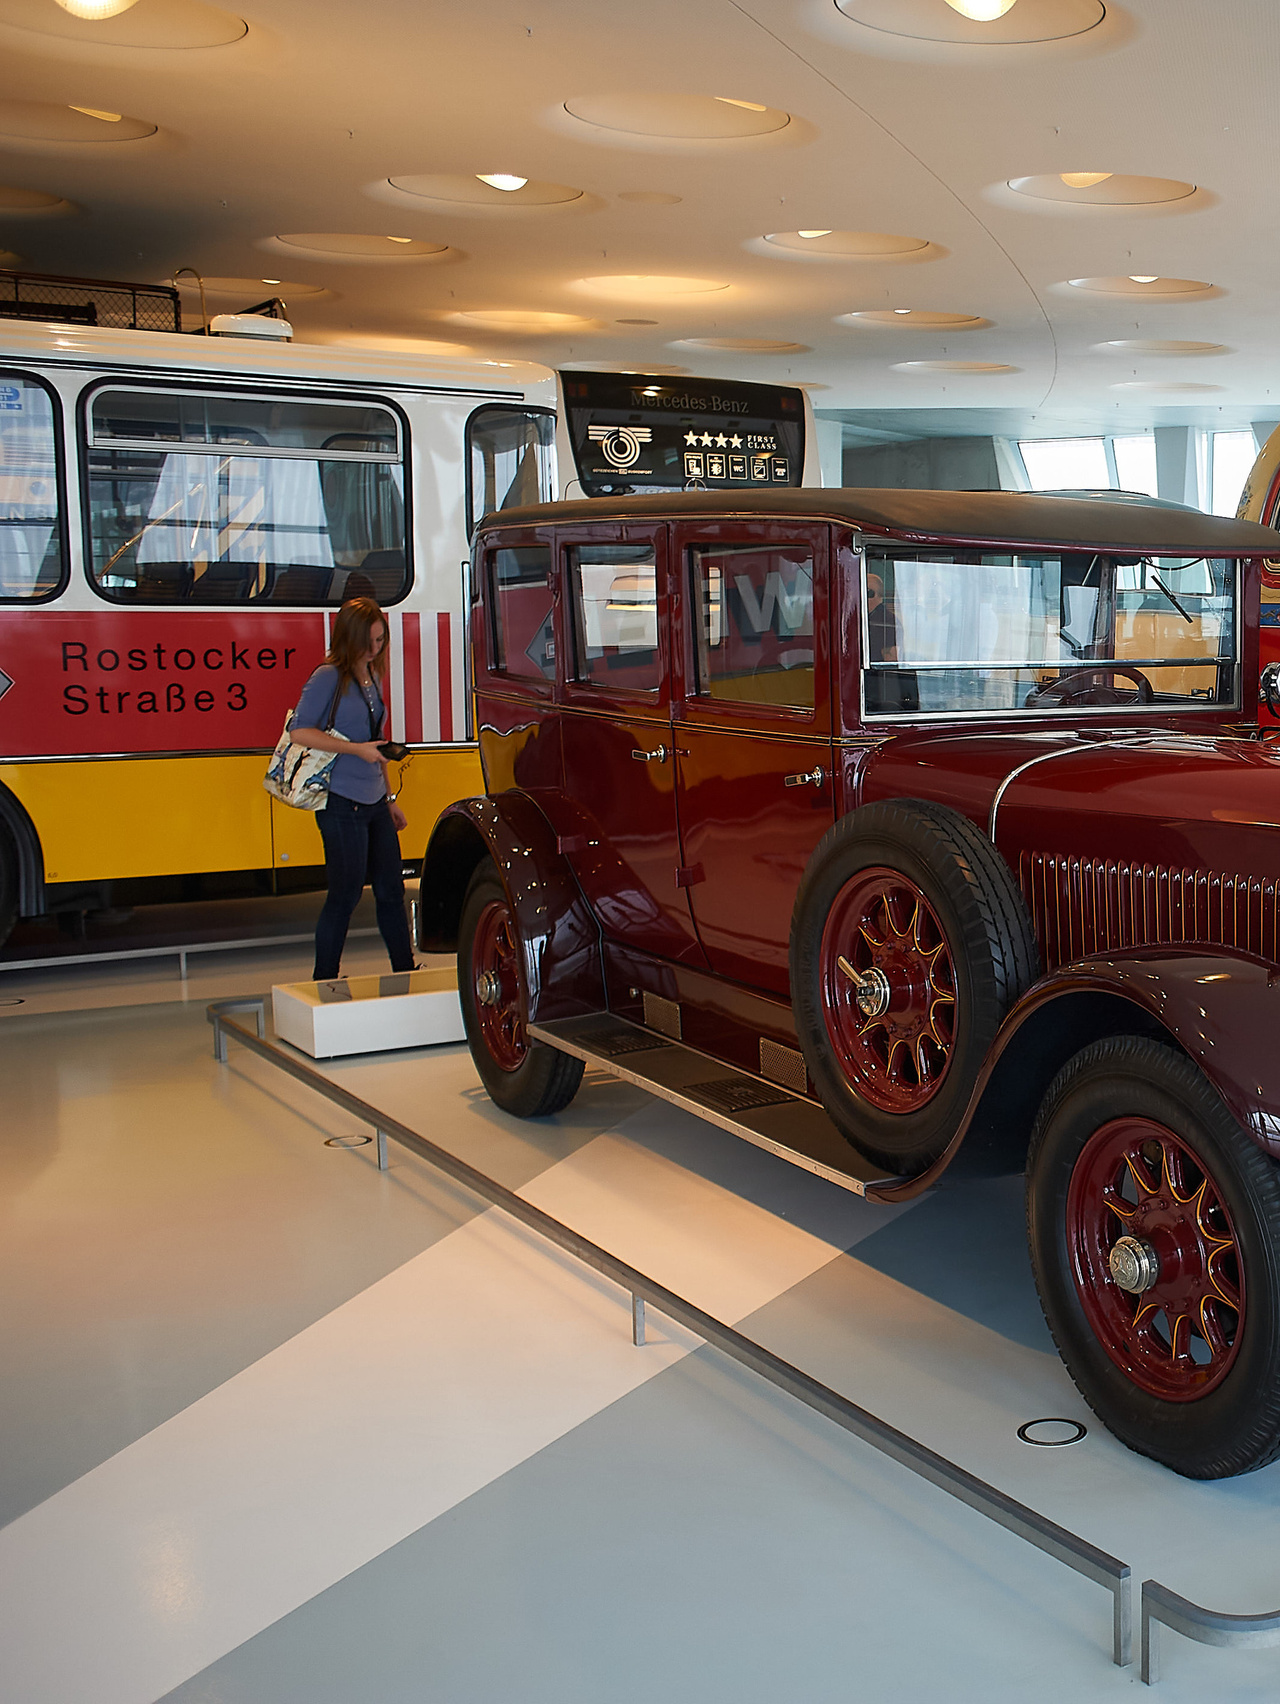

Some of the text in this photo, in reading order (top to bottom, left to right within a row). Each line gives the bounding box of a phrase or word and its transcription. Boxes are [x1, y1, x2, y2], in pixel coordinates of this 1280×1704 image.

[631, 390, 749, 414] Mercedes-Benz
[747, 434, 775, 444] FIRST
[747, 441, 777, 450] CLASS
[733, 465, 744, 473] WC
[61, 641, 297, 672] Rostocker
[62, 683, 249, 716] Straße 3
